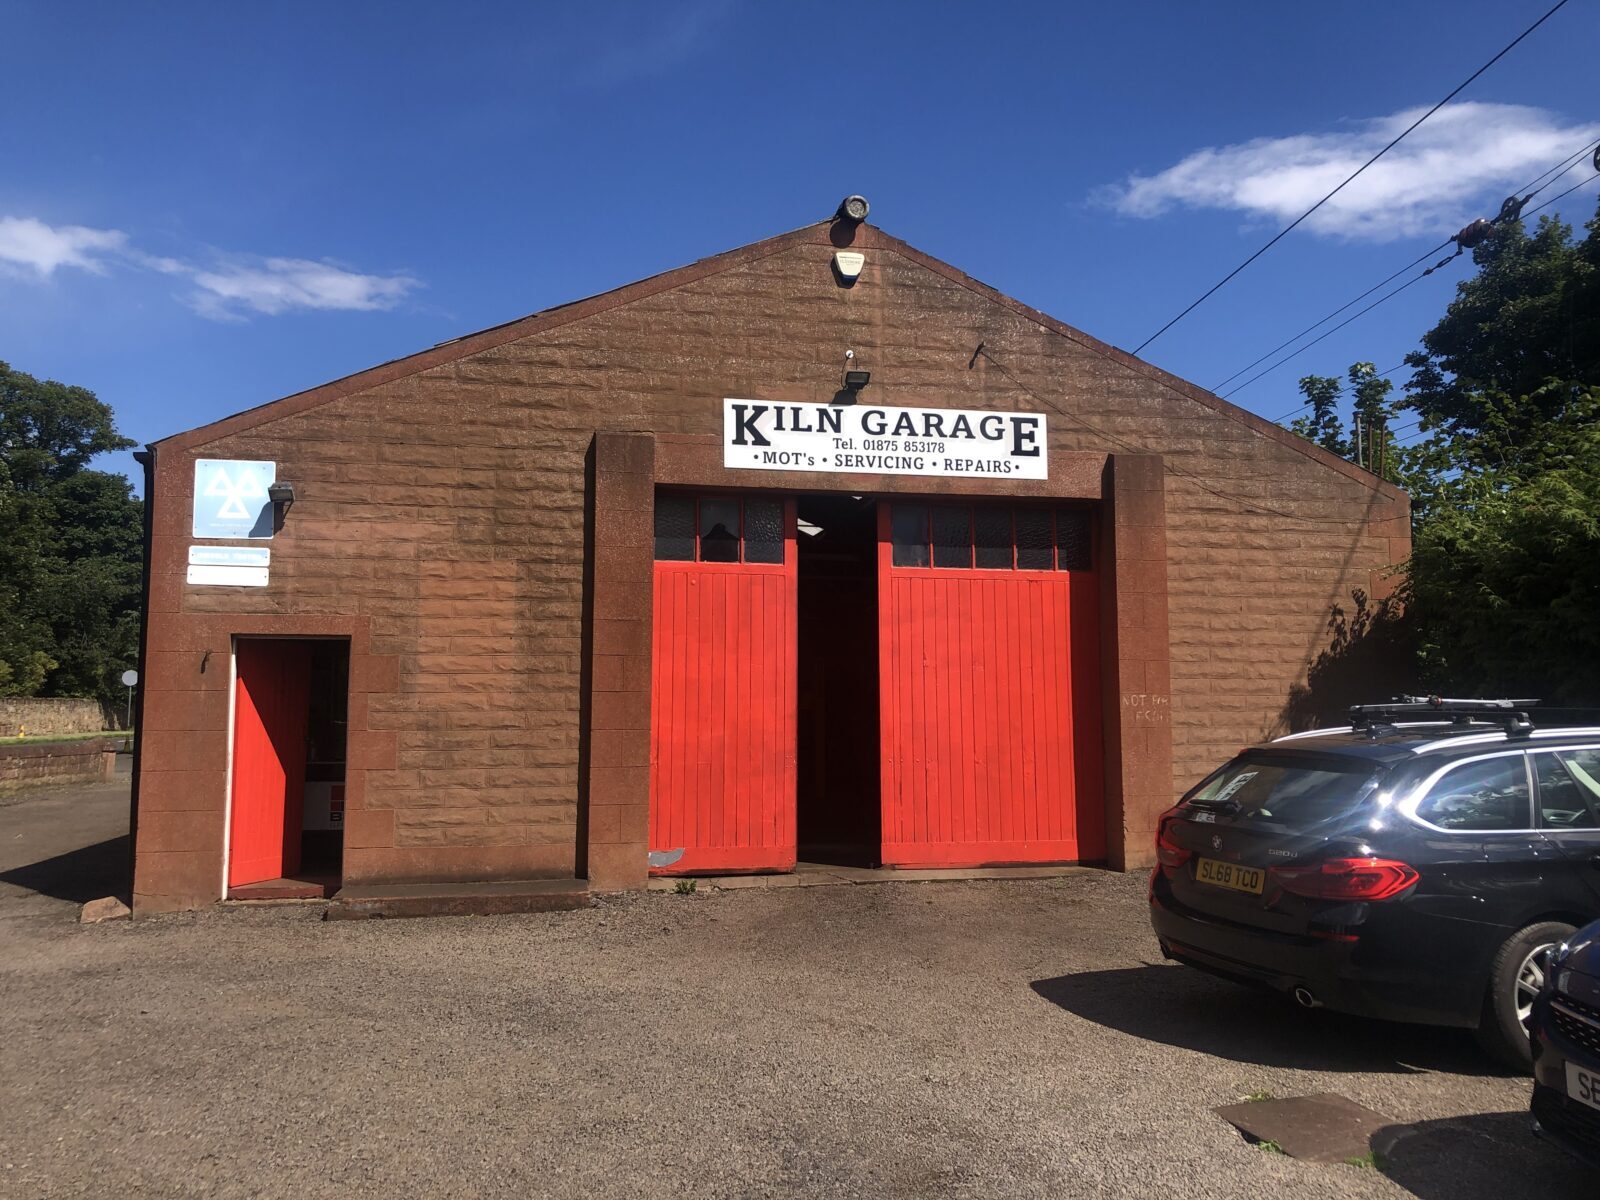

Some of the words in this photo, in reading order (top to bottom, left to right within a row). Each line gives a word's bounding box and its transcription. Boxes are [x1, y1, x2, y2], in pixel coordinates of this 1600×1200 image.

[731, 404, 843, 447] KILN
[861, 410, 1040, 457] GARAGE
[832, 438, 857, 450] Tel.
[863, 440, 898, 452] 01875
[904, 441, 945, 453] 853178
[763, 452, 815, 466] MOT's
[835, 454, 924, 470] SERVICING
[944, 459, 1012, 474] REPAIRS
[1122, 694, 1147, 706] NOT
